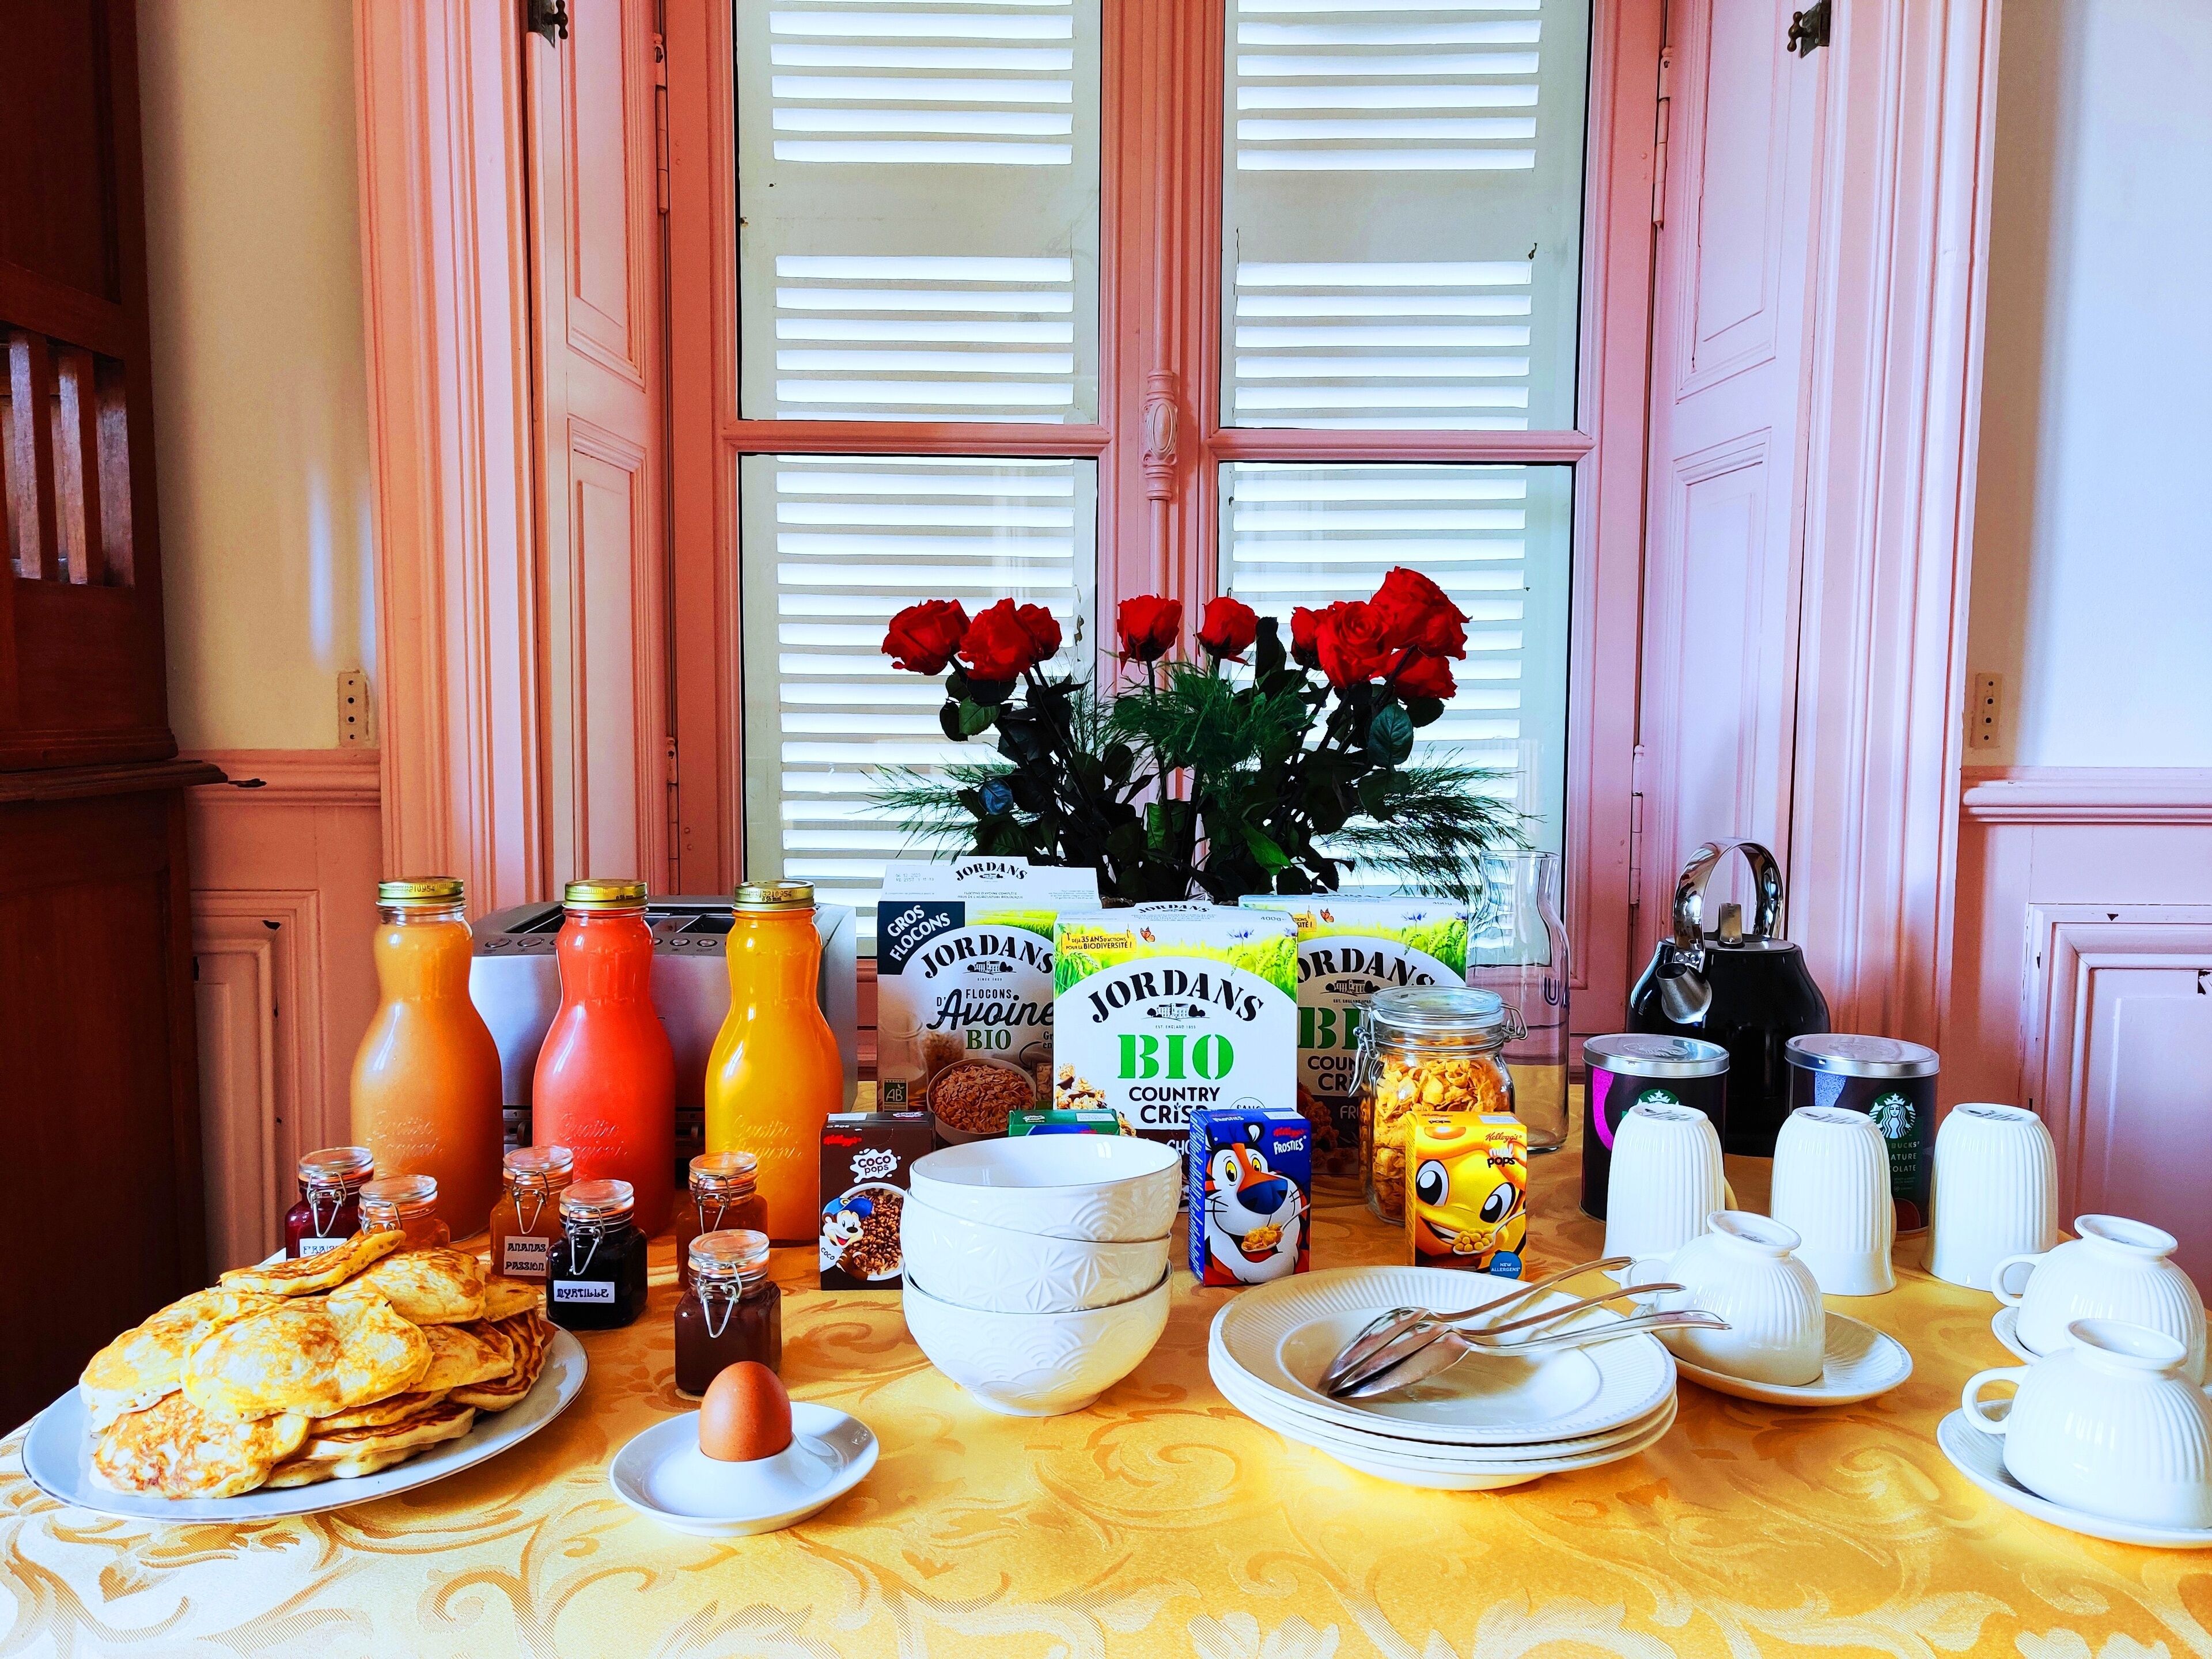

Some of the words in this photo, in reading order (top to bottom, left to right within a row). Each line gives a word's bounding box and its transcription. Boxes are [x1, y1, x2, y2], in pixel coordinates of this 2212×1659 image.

[955, 862, 1028, 881] JORDANS
[1138, 904, 1210, 913] JORDANS
[887, 905, 925, 937] GROS
[889, 912, 950, 961] FLOCONS
[1084, 941, 1128, 949] BIODIVERSITÉ
[921, 934, 1054, 979] JORDANS
[965, 989, 1012, 999] FLOCONS
[1088, 969, 1264, 1022] JORDANS
[1298, 1007, 1360, 1049] BI
[965, 1029, 1011, 1050] BIO
[1118, 1034, 1234, 1080] BIO
[886, 1089, 903, 1101] AB
[1129, 1086, 1221, 1101] COUNTRY
[1485, 1132, 1518, 1143] Kellogg's
[1273, 1138, 1304, 1155] FROSTIES
[864, 1164, 889, 1173] pops
[1487, 1157, 1515, 1168] pops
[507, 1243, 546, 1252] ANANAS
[505, 1262, 545, 1271] PASSION
[556, 1289, 609, 1299] MYRTILLE
